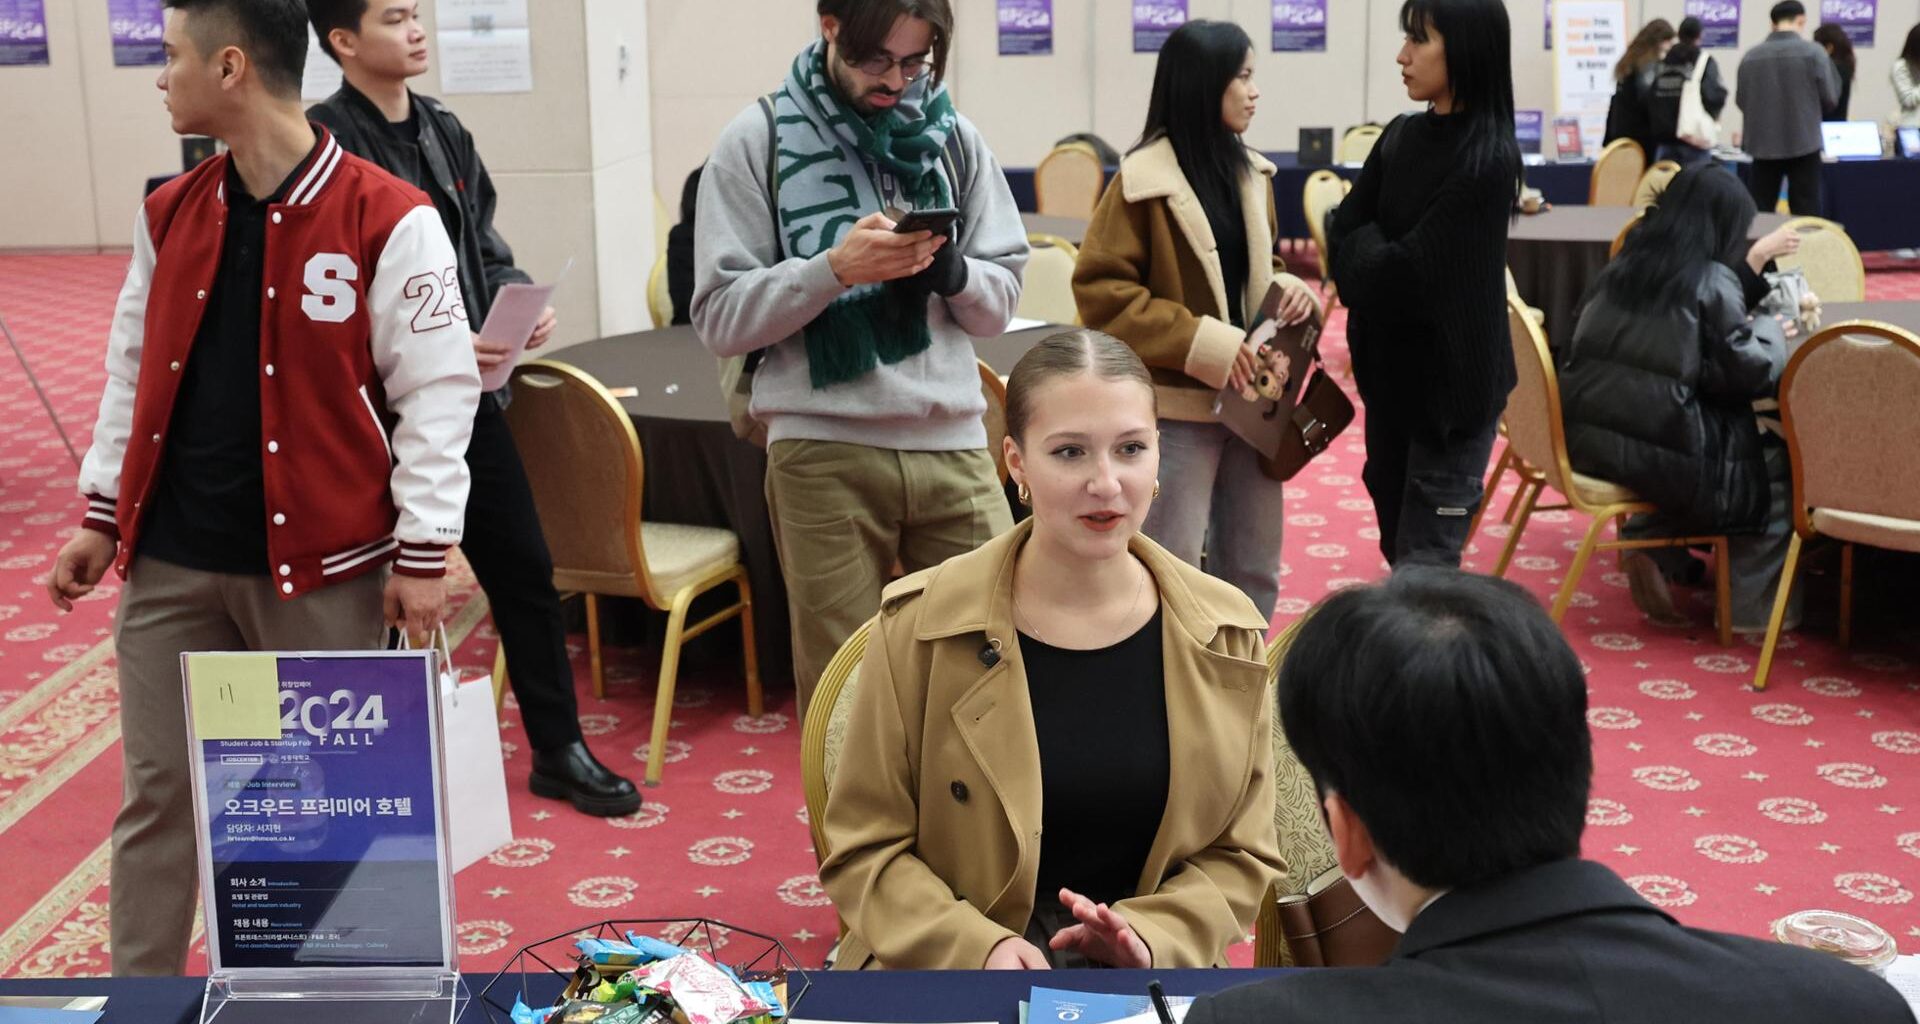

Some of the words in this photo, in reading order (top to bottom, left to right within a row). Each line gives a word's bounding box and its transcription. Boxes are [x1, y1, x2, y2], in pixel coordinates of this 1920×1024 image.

[301, 252, 358, 323] S
[279, 689, 389, 737] 2024
[271, 741, 297, 749] Startup
[319, 733, 374, 746] FALL
[247, 780, 261, 788] Job
[262, 780, 297, 788] Interview
[224, 799, 296, 817] 오크우드
[300, 797, 371, 817] 프리미어
[375, 797, 413, 816] 호텔
[226, 823, 256, 834] 담당자:
[230, 877, 247, 888] 회사
[249, 877, 267, 887] 소개
[233, 918, 251, 929] 채용
[252, 918, 270, 929] 내용
